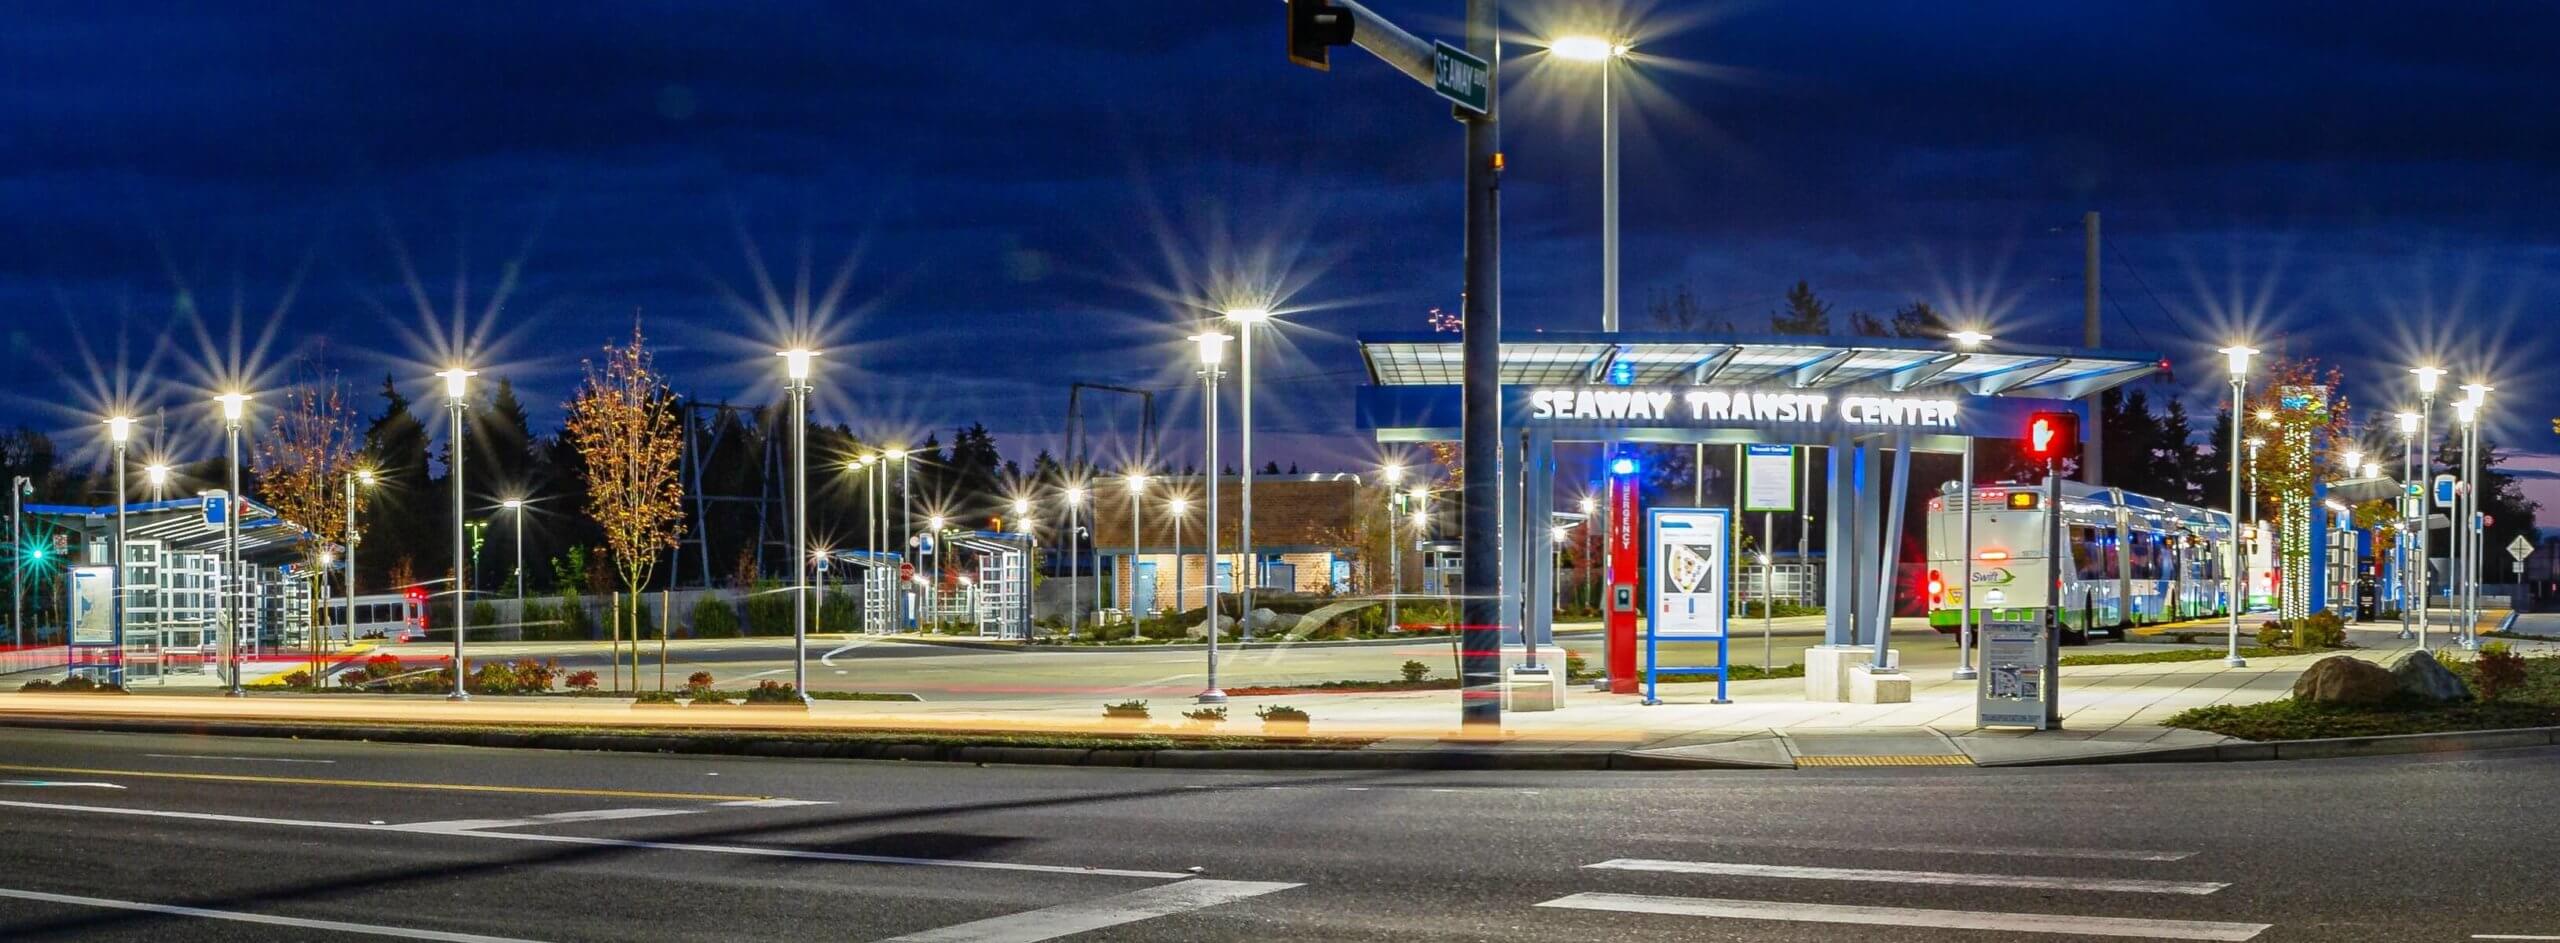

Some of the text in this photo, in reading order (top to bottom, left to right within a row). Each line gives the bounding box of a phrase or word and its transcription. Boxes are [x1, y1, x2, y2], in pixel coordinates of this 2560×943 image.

[1437, 51, 1473, 97] SEAWAY
[1532, 391, 1959, 427] SEAWAY TRANSIT CENTER
[1972, 571, 1999, 583] Swift
